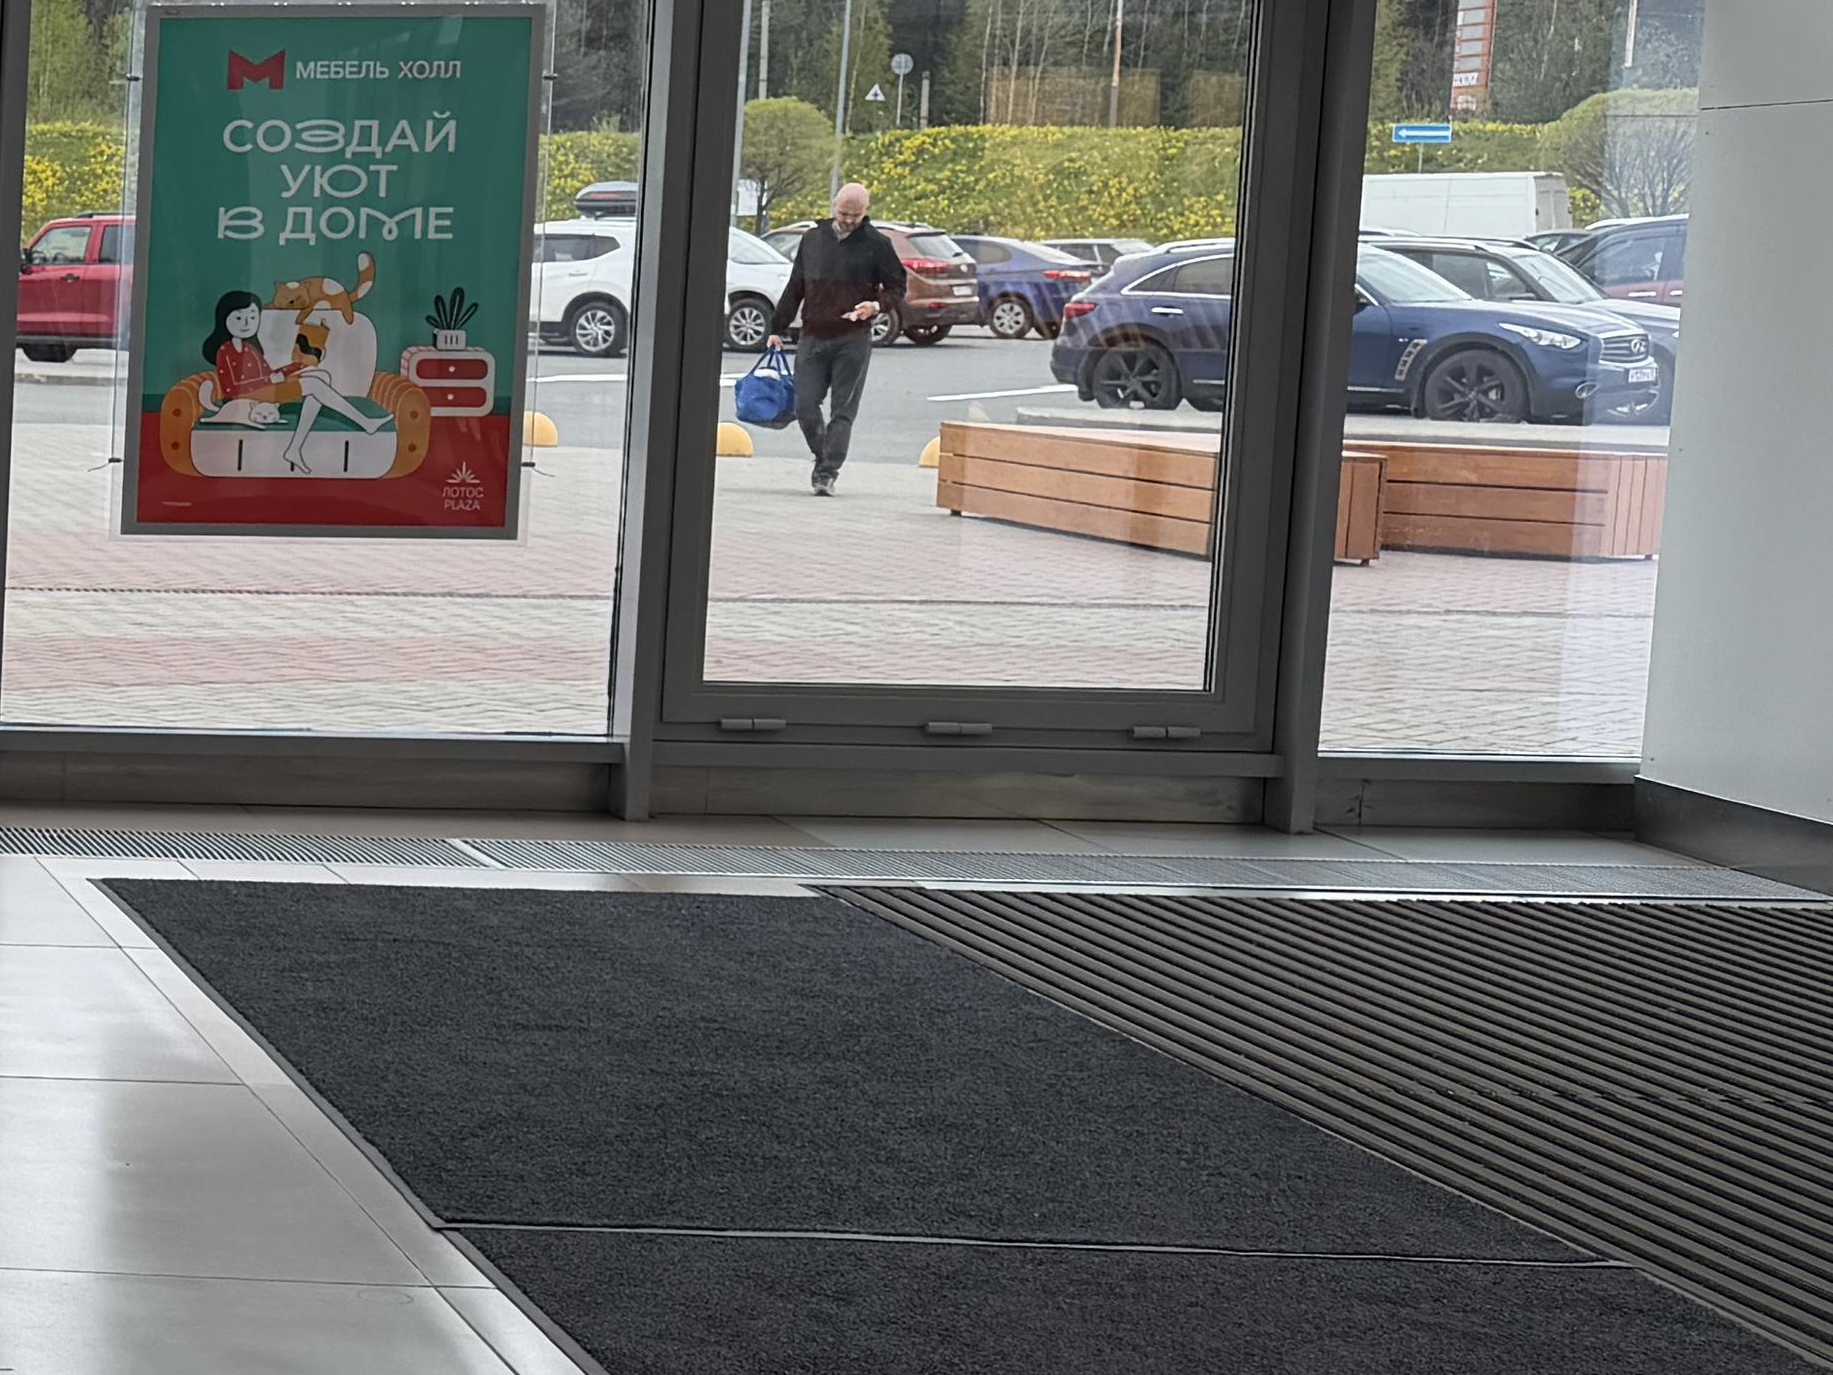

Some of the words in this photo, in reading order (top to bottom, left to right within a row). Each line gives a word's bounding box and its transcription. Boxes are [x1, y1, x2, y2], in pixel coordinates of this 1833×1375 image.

[295, 60, 390, 79] МЕБЕЛЬ
[397, 60, 461, 79] ХОЛЛ
[223, 111, 457, 159] СОЗДАЙ
[279, 163, 398, 199] УЮТ
[217, 207, 265, 240] В
[279, 206, 454, 246] ДОМЕ
[442, 486, 484, 499] ЛОТОС
[444, 500, 481, 511] PLAZA
